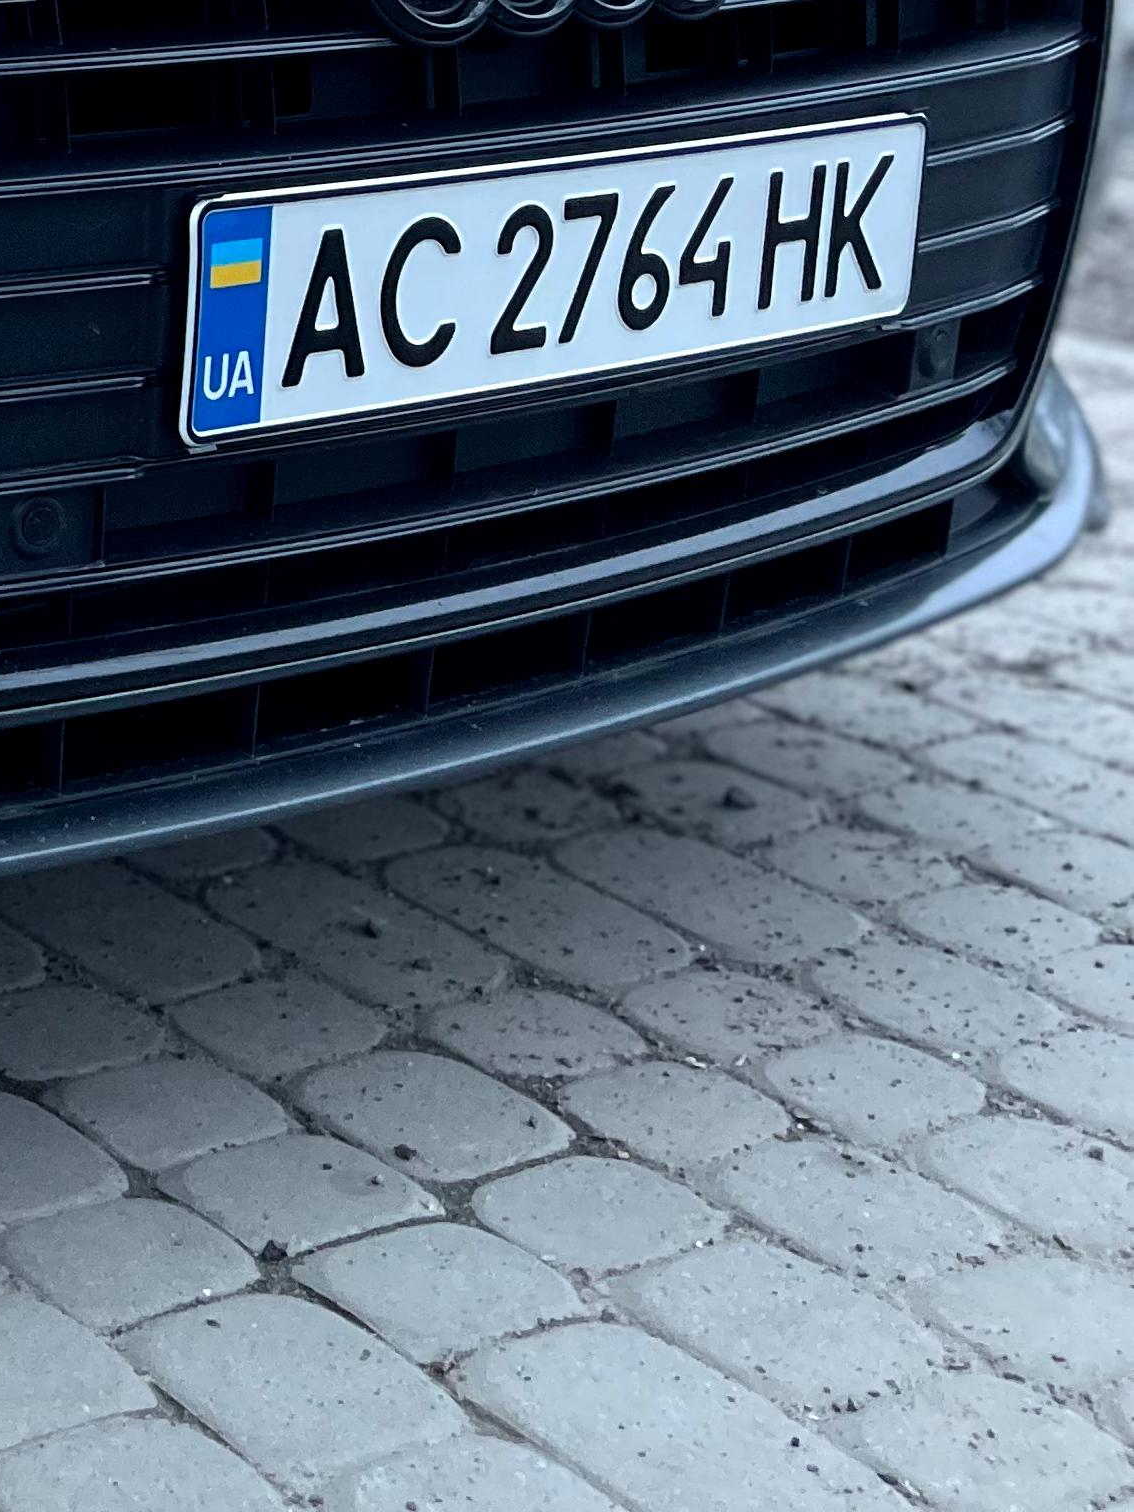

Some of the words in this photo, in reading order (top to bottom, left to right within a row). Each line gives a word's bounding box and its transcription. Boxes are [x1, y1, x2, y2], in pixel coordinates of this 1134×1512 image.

[281, 216, 461, 388] AC
[489, 176, 734, 355] 2764
[757, 154, 895, 311] HK
[203, 350, 255, 400] UA
